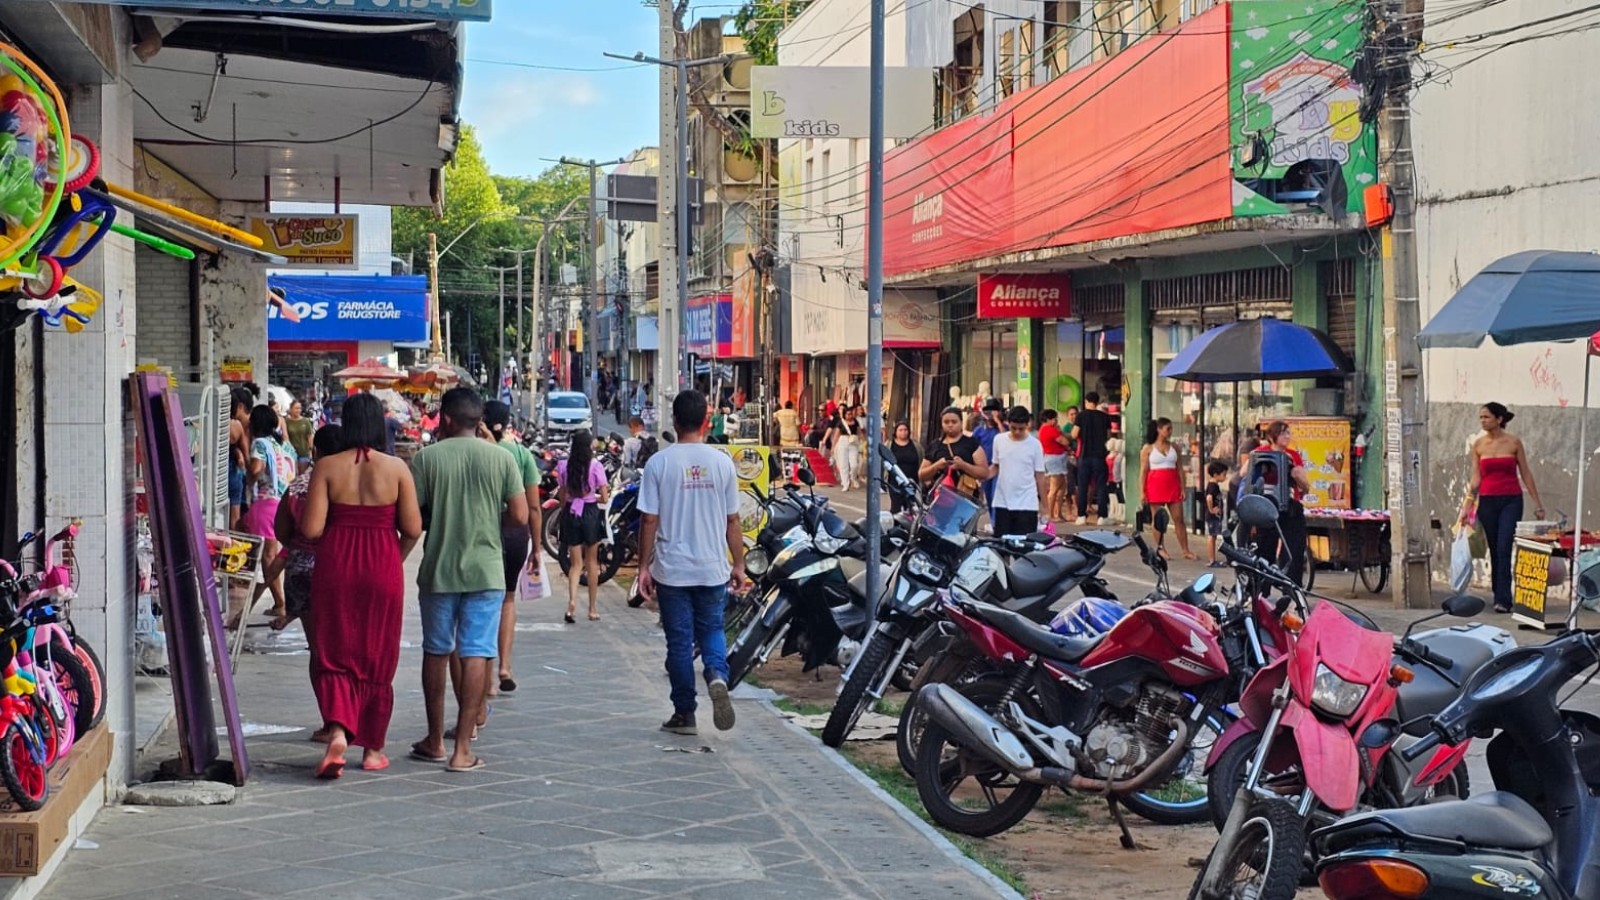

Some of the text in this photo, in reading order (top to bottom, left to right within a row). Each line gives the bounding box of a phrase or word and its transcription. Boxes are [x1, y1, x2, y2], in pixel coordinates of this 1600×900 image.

[784, 120, 840, 136] kids
[1272, 135, 1348, 164] kids
[912, 192, 943, 225] Aliança
[303, 229, 341, 244] Suco
[990, 284, 1060, 301] Aliança
[337, 300, 394, 310] FARMÁCIA
[337, 310, 401, 319] DRUGSTORE
